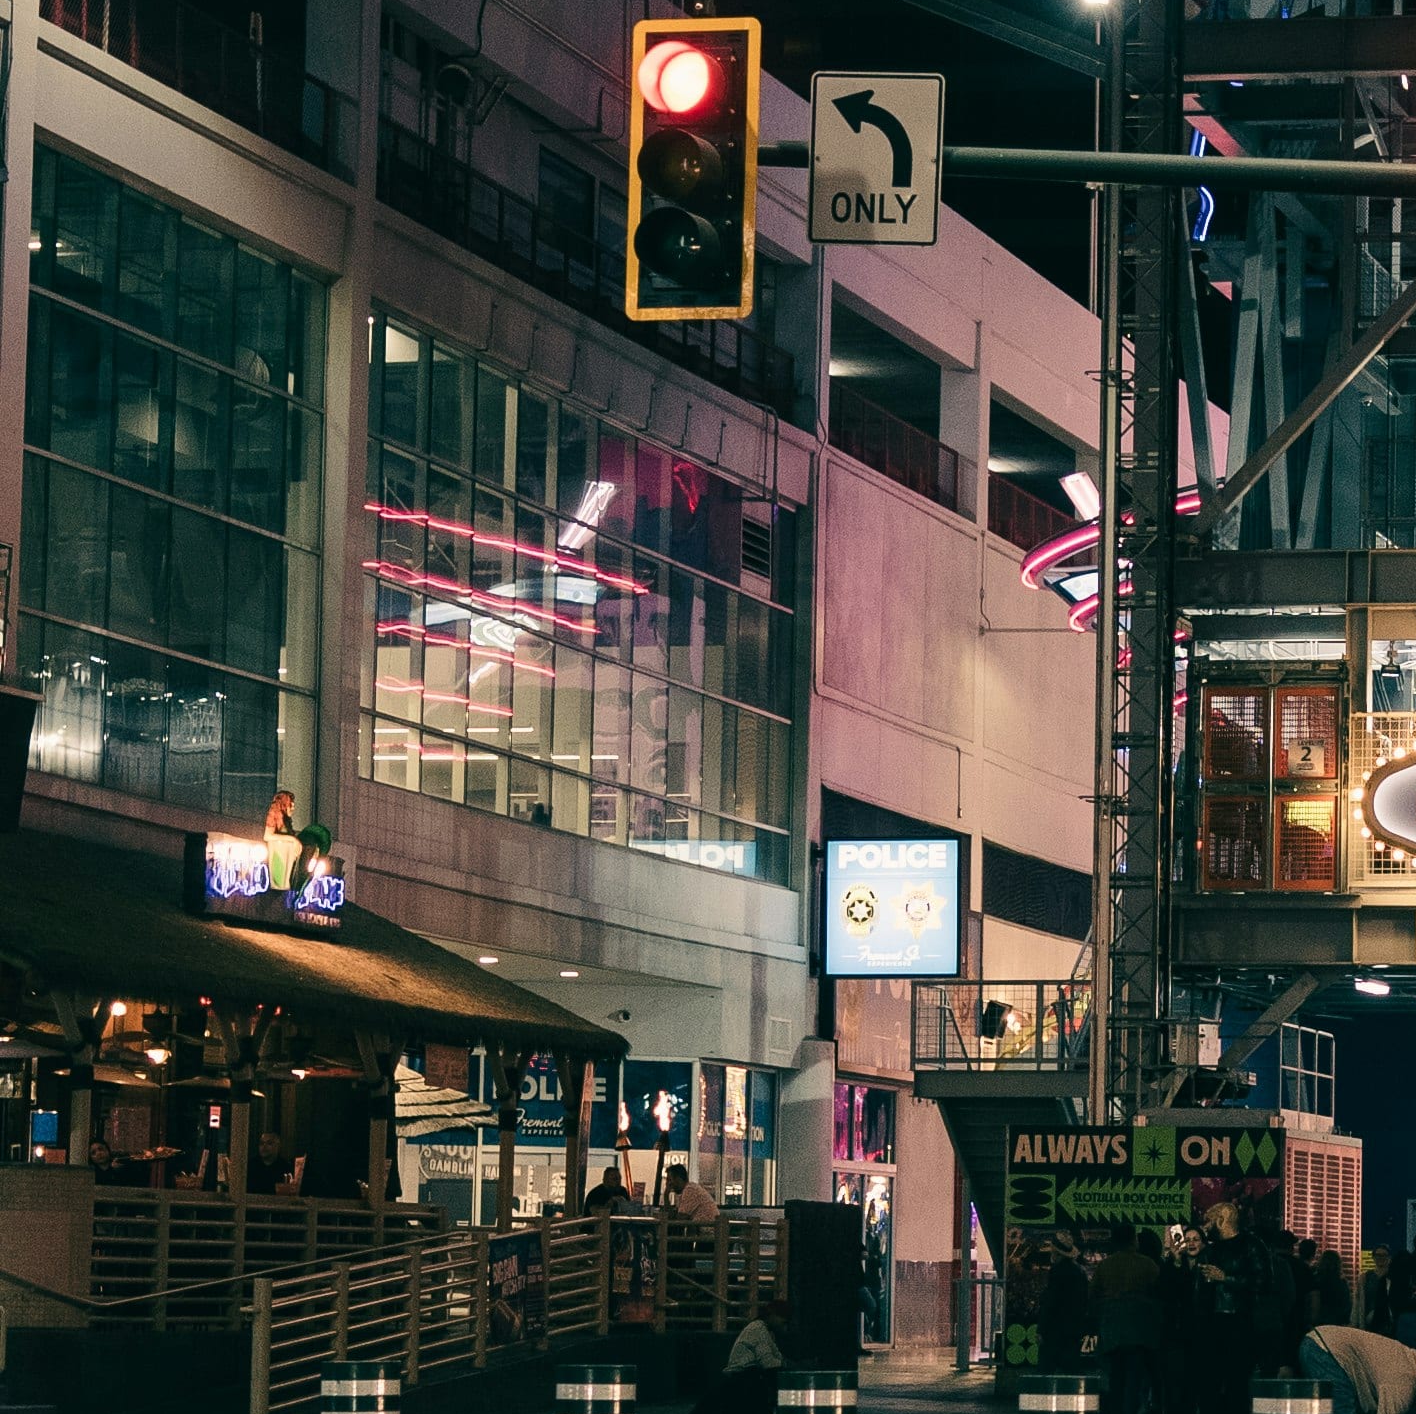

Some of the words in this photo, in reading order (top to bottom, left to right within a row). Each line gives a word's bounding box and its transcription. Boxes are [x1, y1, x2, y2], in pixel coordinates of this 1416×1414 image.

[831, 192, 918, 224] ONLY
[838, 844, 947, 869] POLICE
[492, 1076, 606, 1103] OLIE
[1013, 1134, 1128, 1165] ALWAYS
[1180, 1135, 1231, 1166] ON
[429, 1158, 475, 1175] GAMBLIN
[1072, 1192, 1121, 1204] SLOTZILLA
[1123, 1193, 1145, 1204] BOX
[1148, 1194, 1185, 1204] OFFICE
